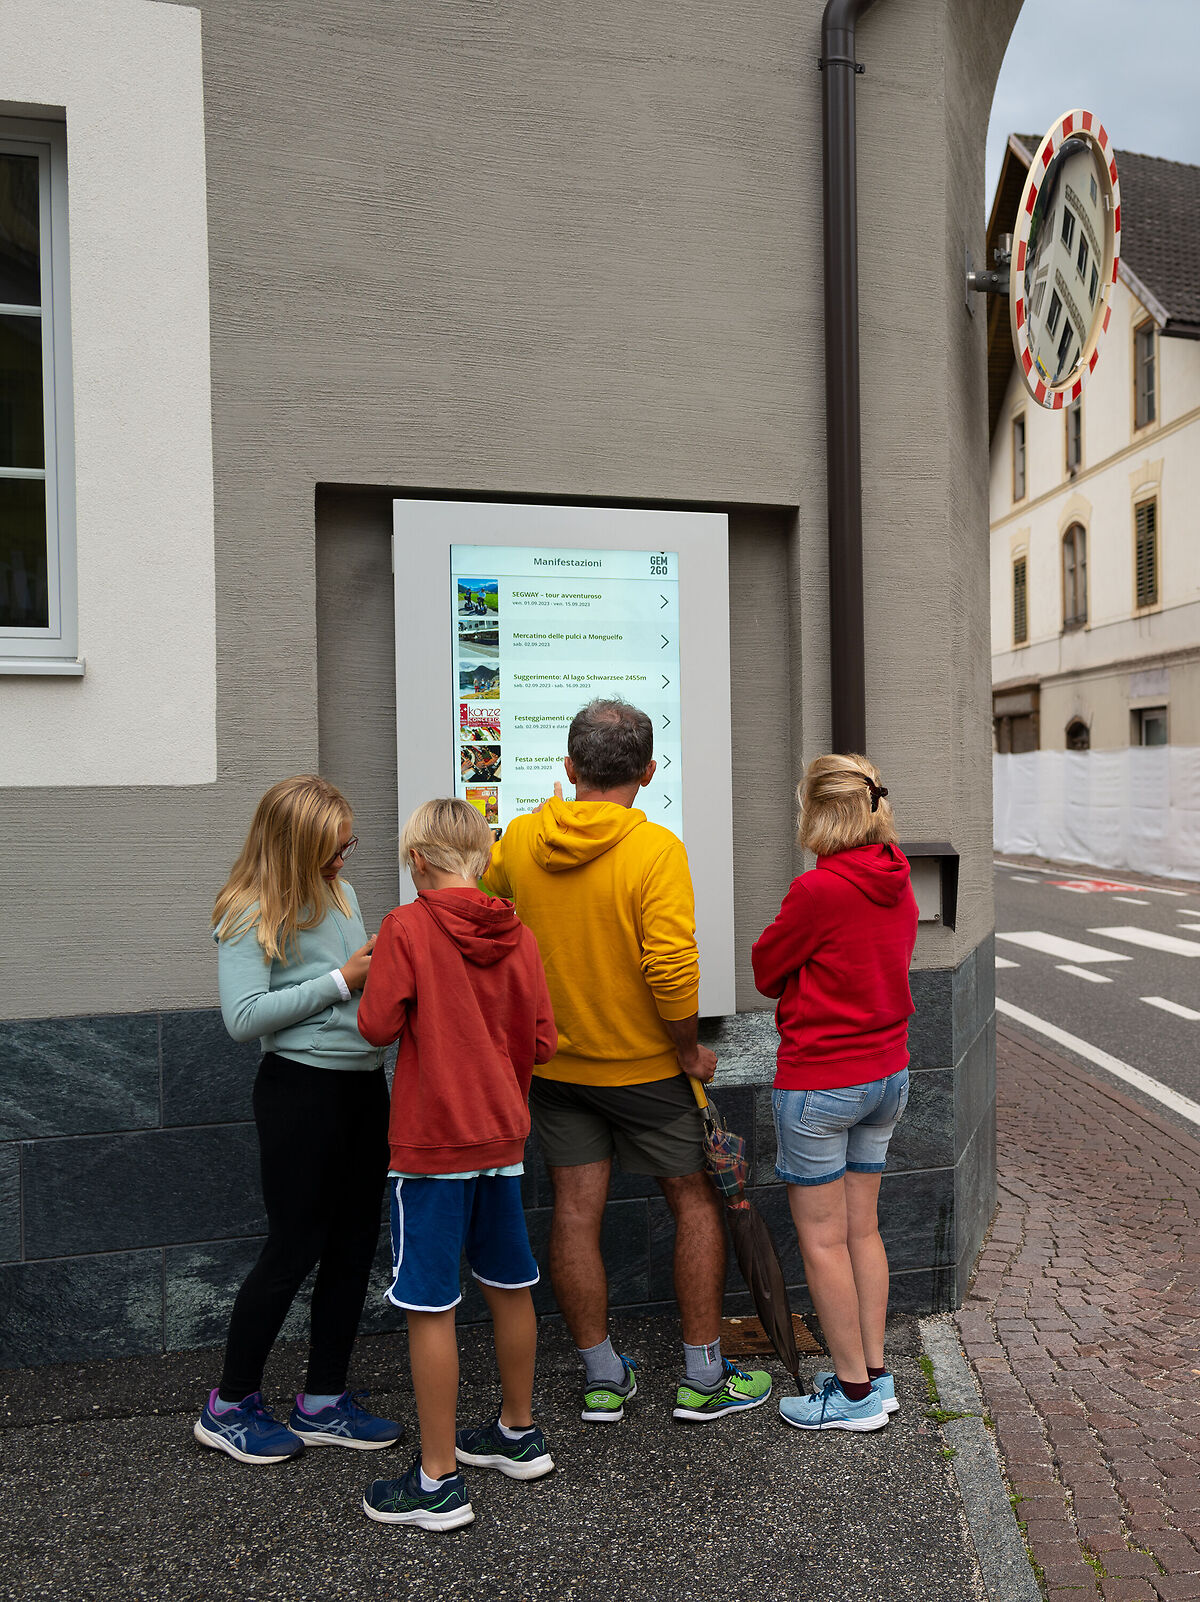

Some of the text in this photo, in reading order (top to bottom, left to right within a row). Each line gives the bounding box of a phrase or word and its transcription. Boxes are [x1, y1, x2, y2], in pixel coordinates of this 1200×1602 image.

[533, 557, 602, 567] Manifestazioni
[650, 556, 668, 566] GEM
[650, 566, 668, 575] 2GO
[566, 633, 581, 641] pulci
[588, 633, 623, 641] Monguelfo
[513, 674, 562, 682] Suggerimento:
[571, 674, 585, 682] lago
